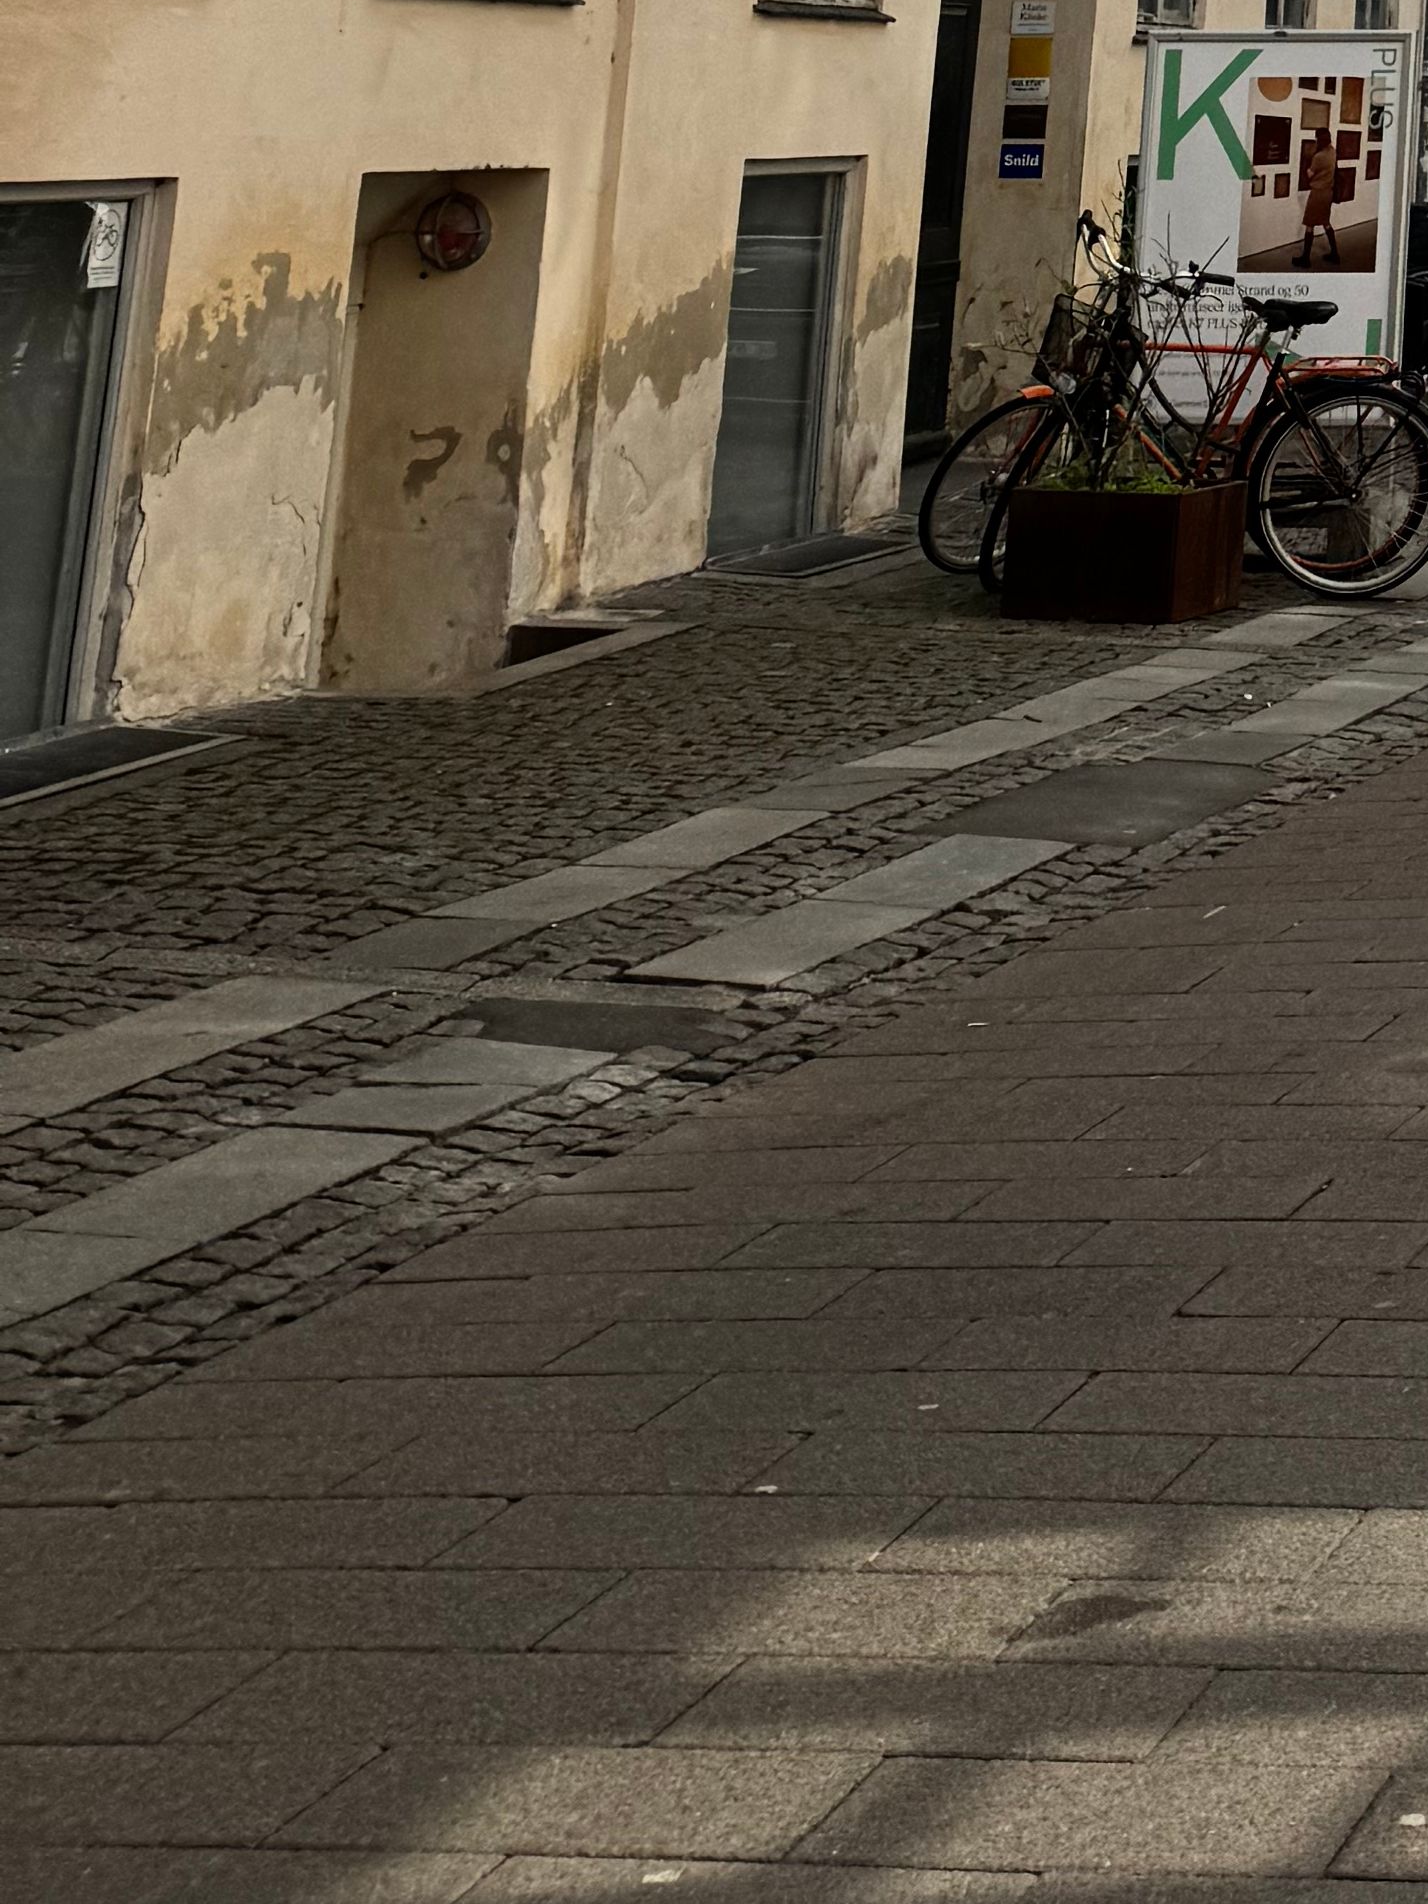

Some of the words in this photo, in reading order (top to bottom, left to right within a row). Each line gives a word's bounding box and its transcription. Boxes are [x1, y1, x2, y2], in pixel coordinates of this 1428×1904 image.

[1368, 48, 1397, 130] PLUS
[1156, 48, 1265, 181] K
[1004, 154, 1040, 167] Snild
[1239, 284, 1276, 297] Strand
[1294, 284, 1309, 297] 50
[1207, 318, 1238, 329] PLUS
